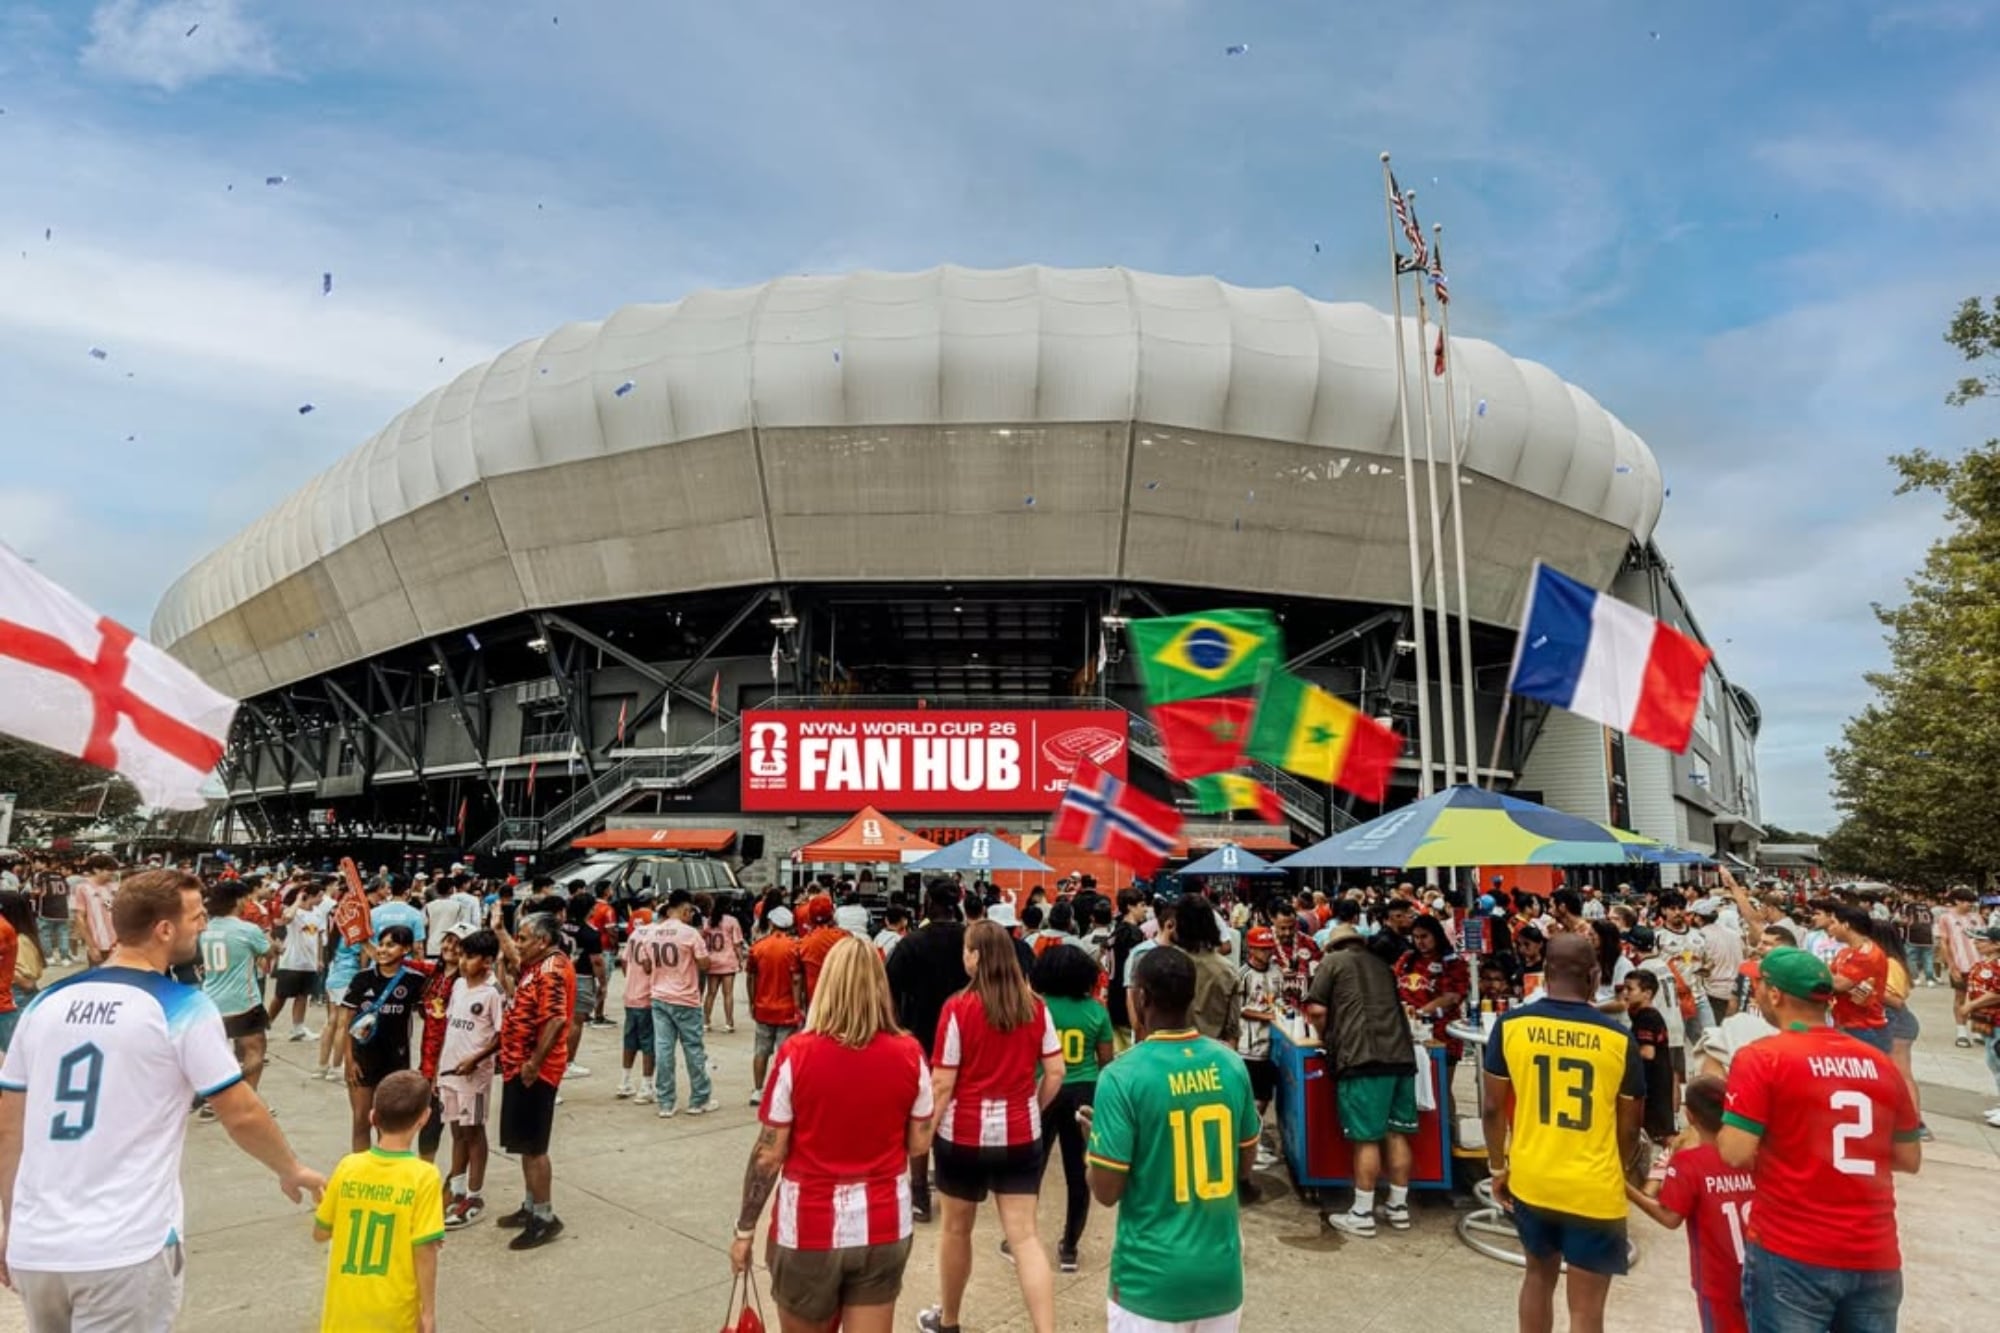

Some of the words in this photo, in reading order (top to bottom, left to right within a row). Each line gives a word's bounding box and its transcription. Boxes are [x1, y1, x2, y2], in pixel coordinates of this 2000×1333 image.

[862, 722, 937, 735] WORLD
[940, 722, 983, 735] CUP
[989, 722, 1017, 735] 26
[800, 738, 901, 791] FAN
[913, 738, 1021, 791] HUB
[201, 941, 227, 971] 10
[651, 941, 679, 967] 10
[65, 1000, 123, 1024] KANE
[1056, 1029, 1084, 1062] 0
[1527, 1026, 1601, 1051] VALENCIA
[1168, 1062, 1223, 1096] MANÉ
[1808, 1056, 1879, 1080] HAKIMI
[50, 1040, 104, 1140] 9
[1533, 1054, 1594, 1132] 13
[1829, 1090, 1876, 1176] 2
[1169, 1103, 1234, 1203] 10
[395, 1187, 416, 1206] JR
[1705, 1174, 1756, 1193] PANAM
[341, 1209, 396, 1276] 10
